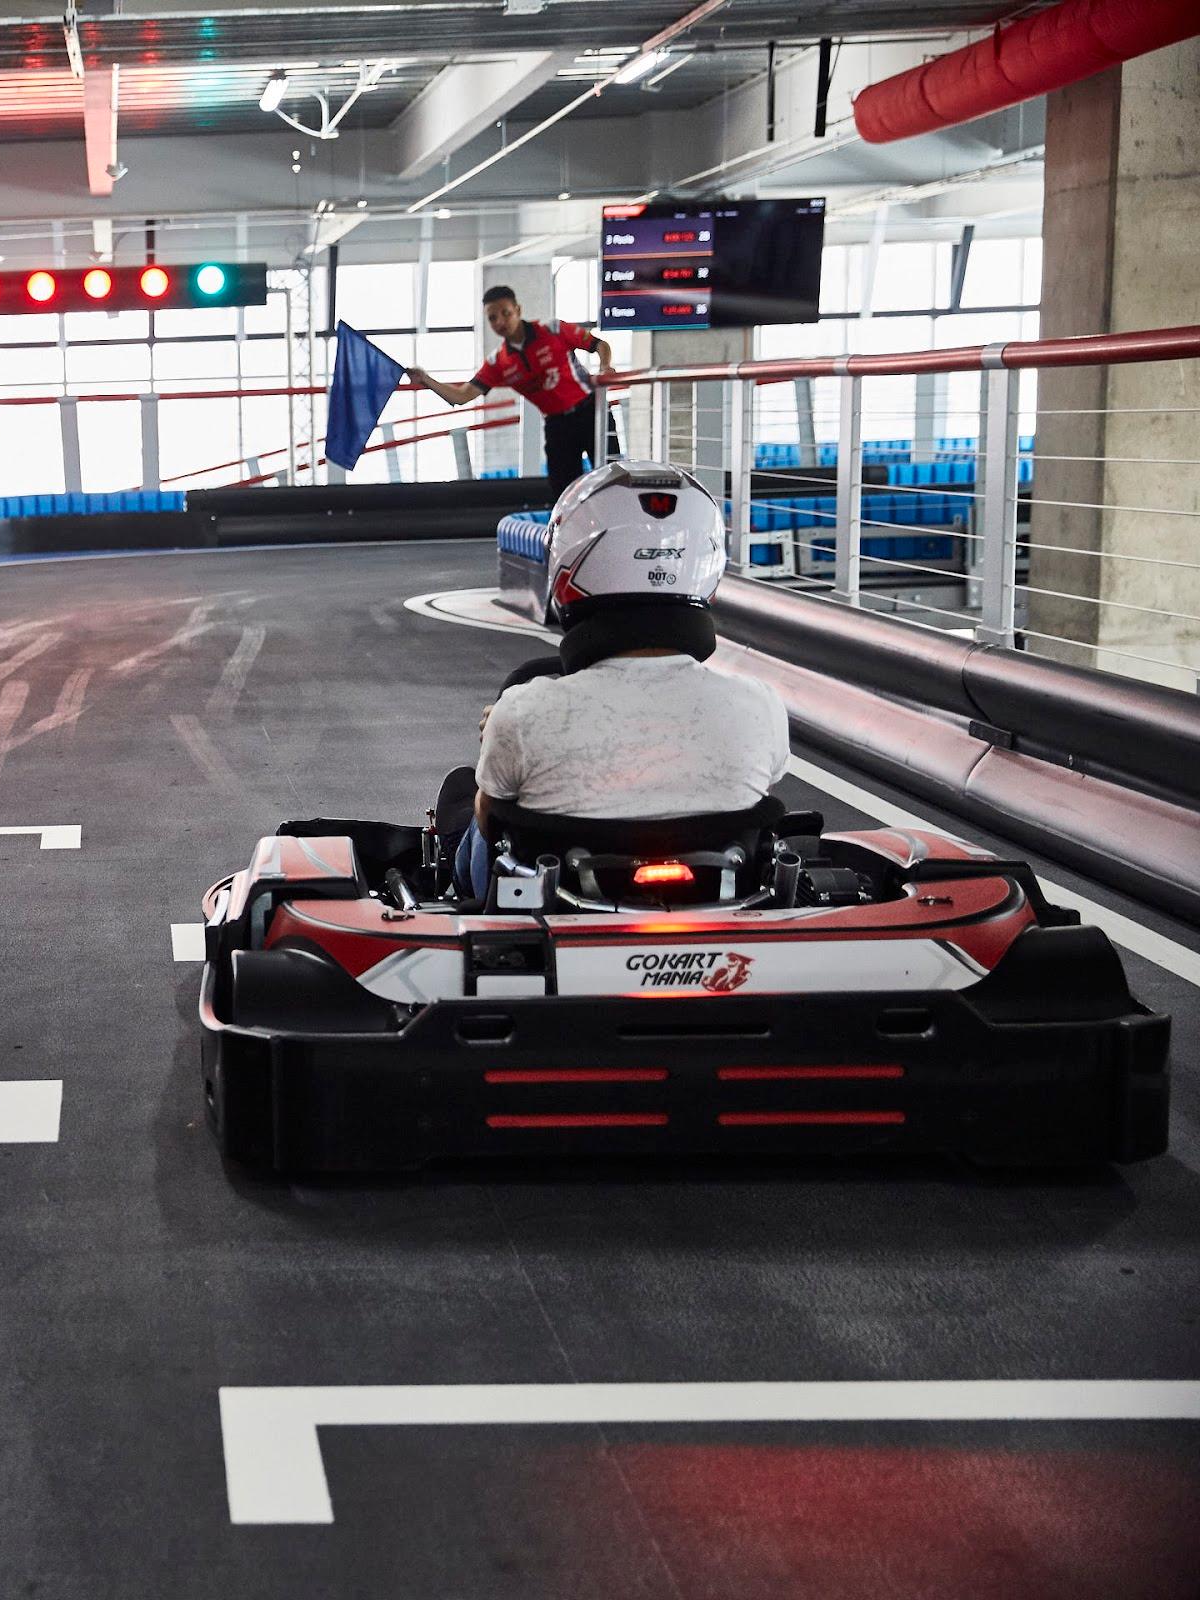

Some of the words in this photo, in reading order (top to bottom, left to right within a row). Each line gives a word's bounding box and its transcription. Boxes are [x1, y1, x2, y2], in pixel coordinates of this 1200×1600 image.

[650, 496, 670, 511] M
[633, 548, 685, 560] GPX
[648, 571, 667, 581] DOT
[626, 952, 723, 971] GOKART
[641, 970, 704, 986] MANIA
